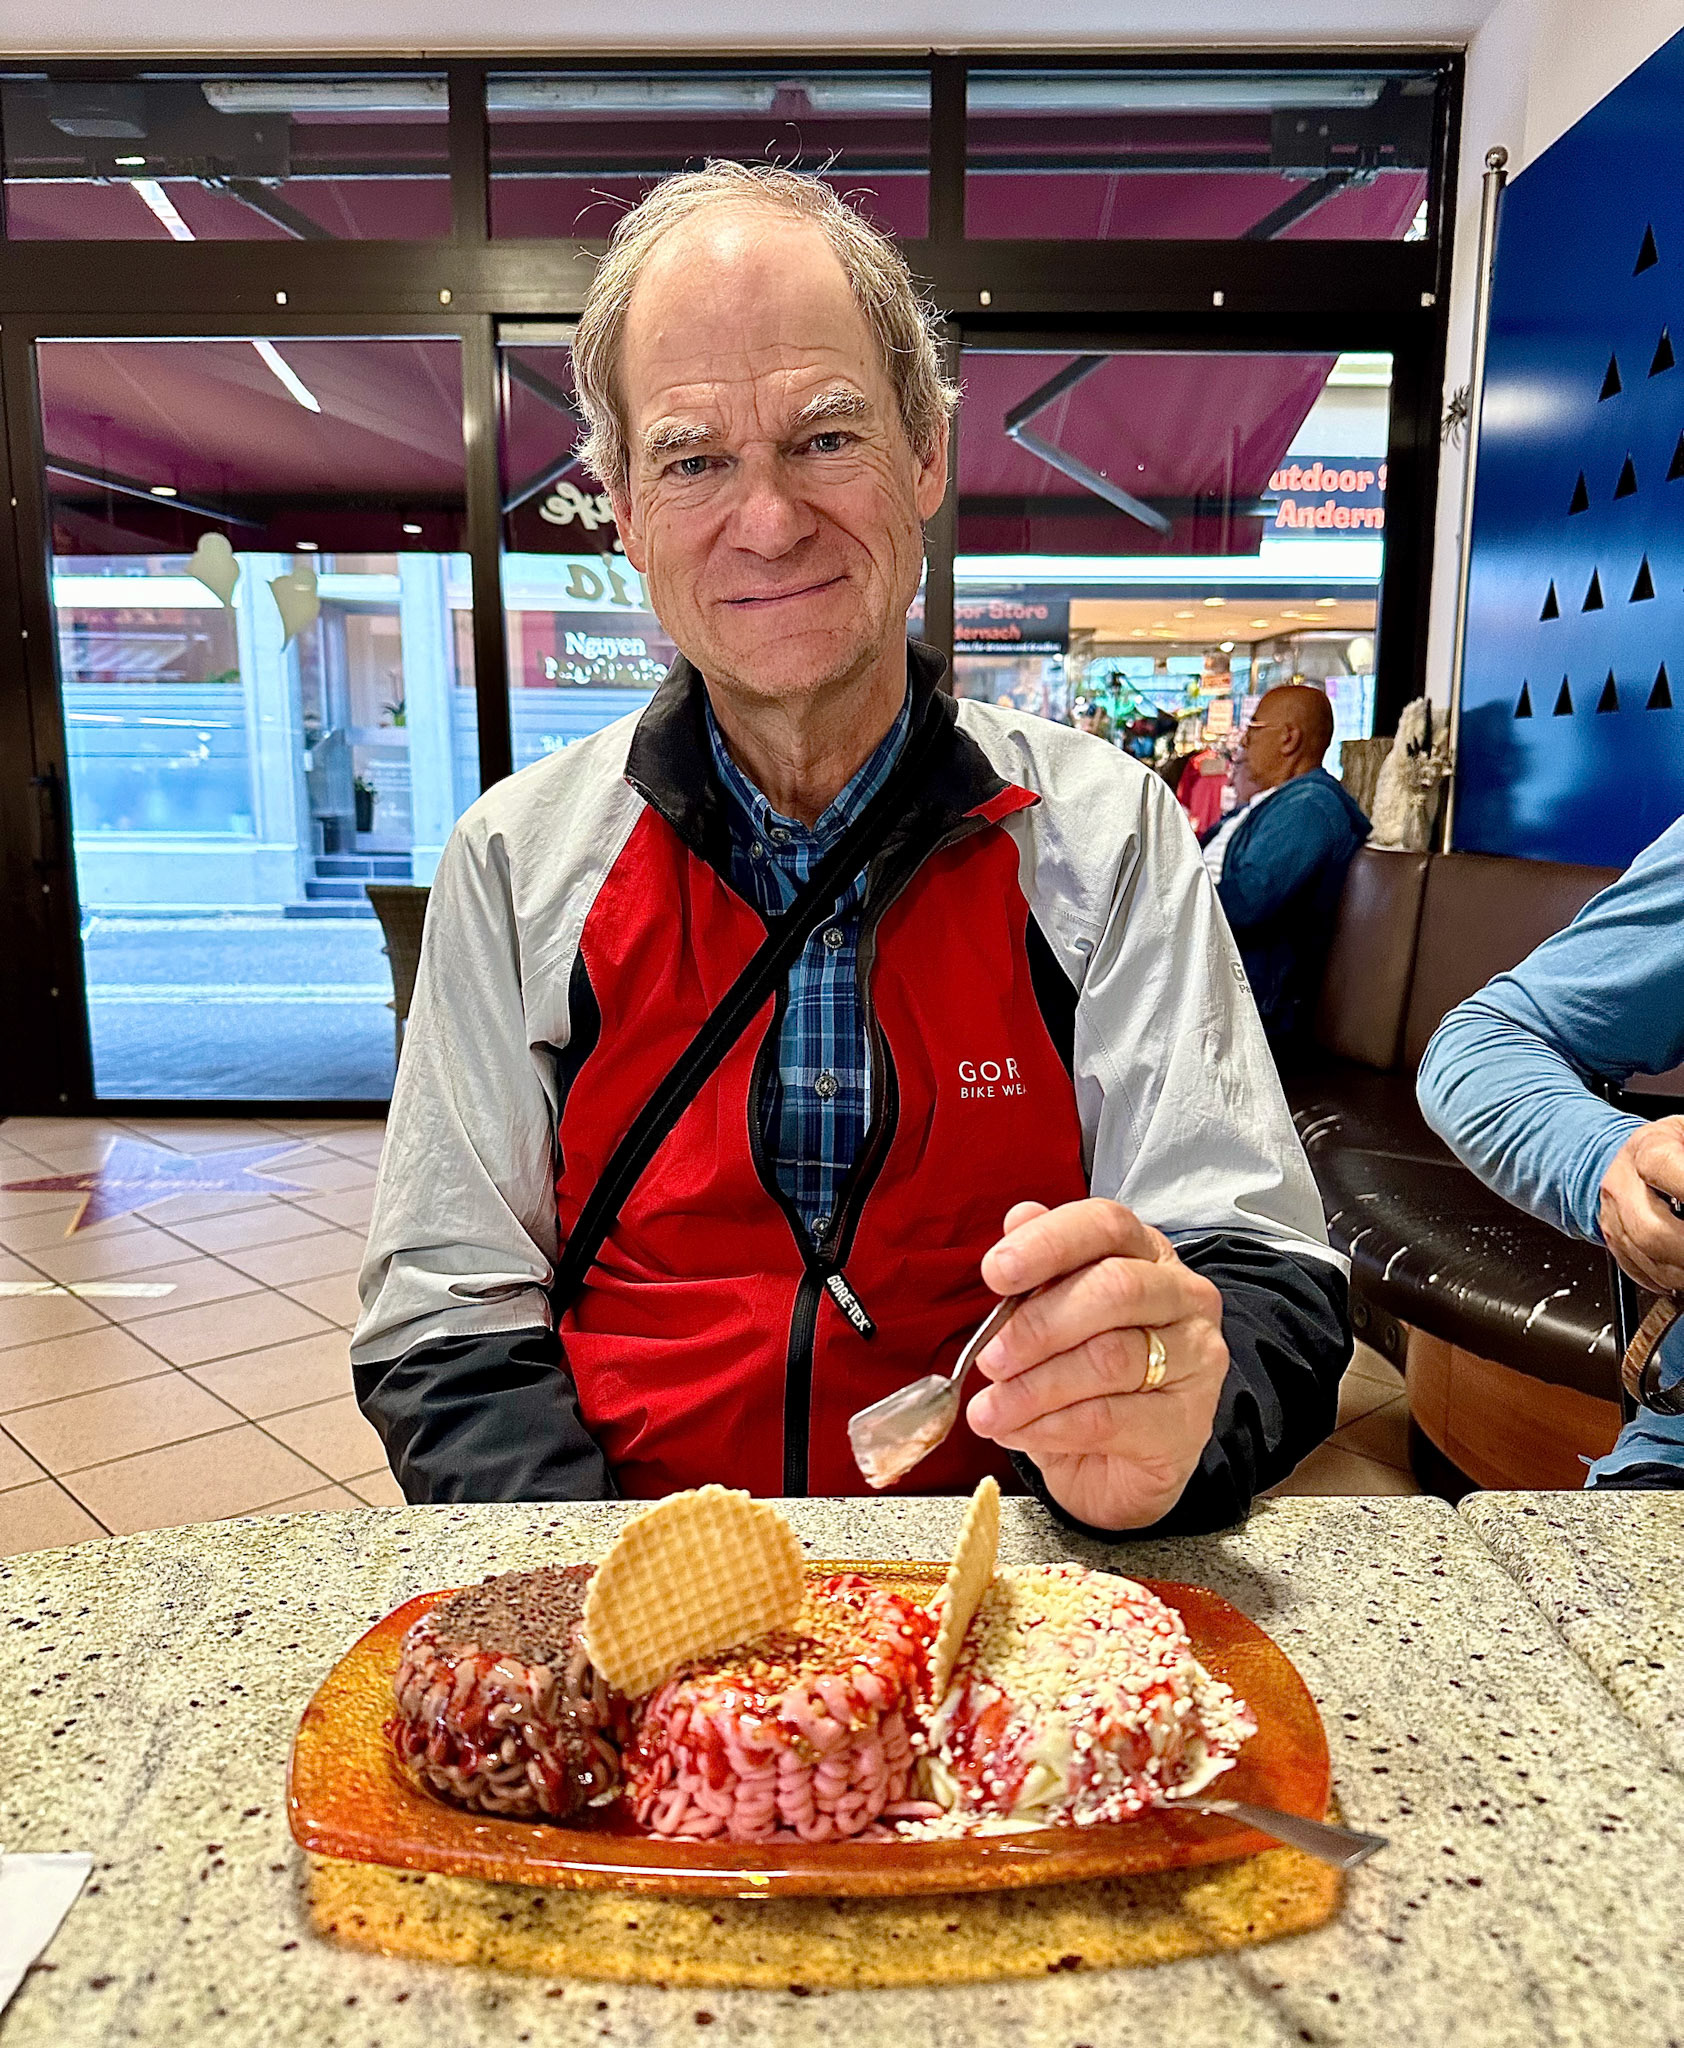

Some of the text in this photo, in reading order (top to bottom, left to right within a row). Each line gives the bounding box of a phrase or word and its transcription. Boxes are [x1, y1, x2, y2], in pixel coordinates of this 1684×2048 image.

[988, 599, 1049, 619] Store
[565, 632, 646, 659] Nguyen
[960, 1086, 995, 1099] BIKE
